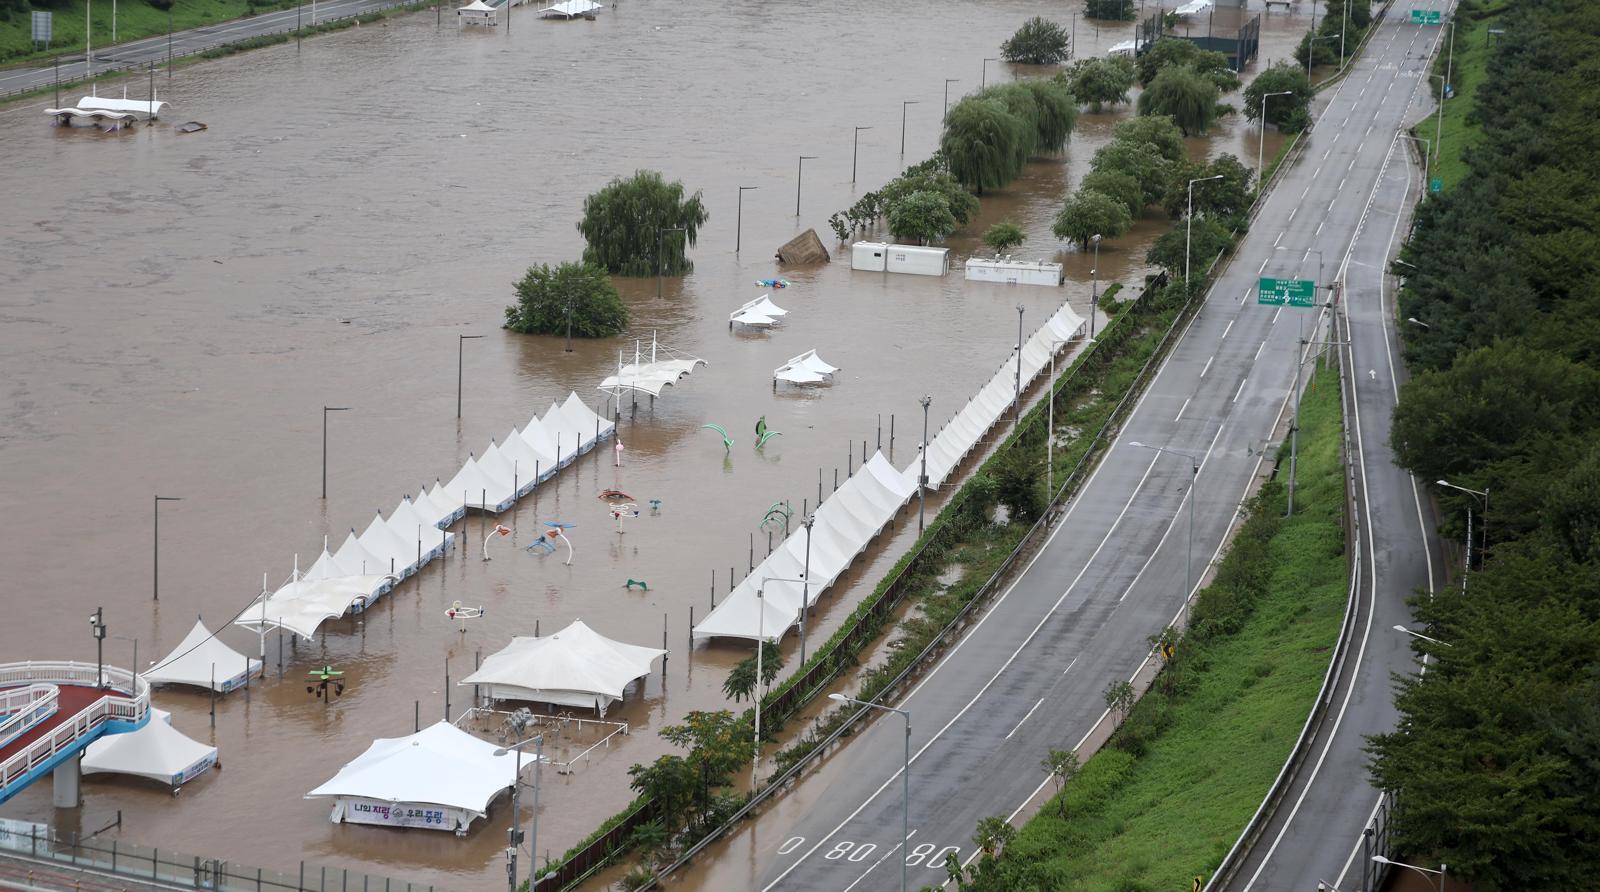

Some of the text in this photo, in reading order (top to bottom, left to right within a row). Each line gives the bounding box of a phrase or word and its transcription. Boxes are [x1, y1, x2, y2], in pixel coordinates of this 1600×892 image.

[354, 803, 442, 824] 나의 자랑 우리 중랑
[824, 841, 877, 862] 80
[905, 843, 961, 869] 80
